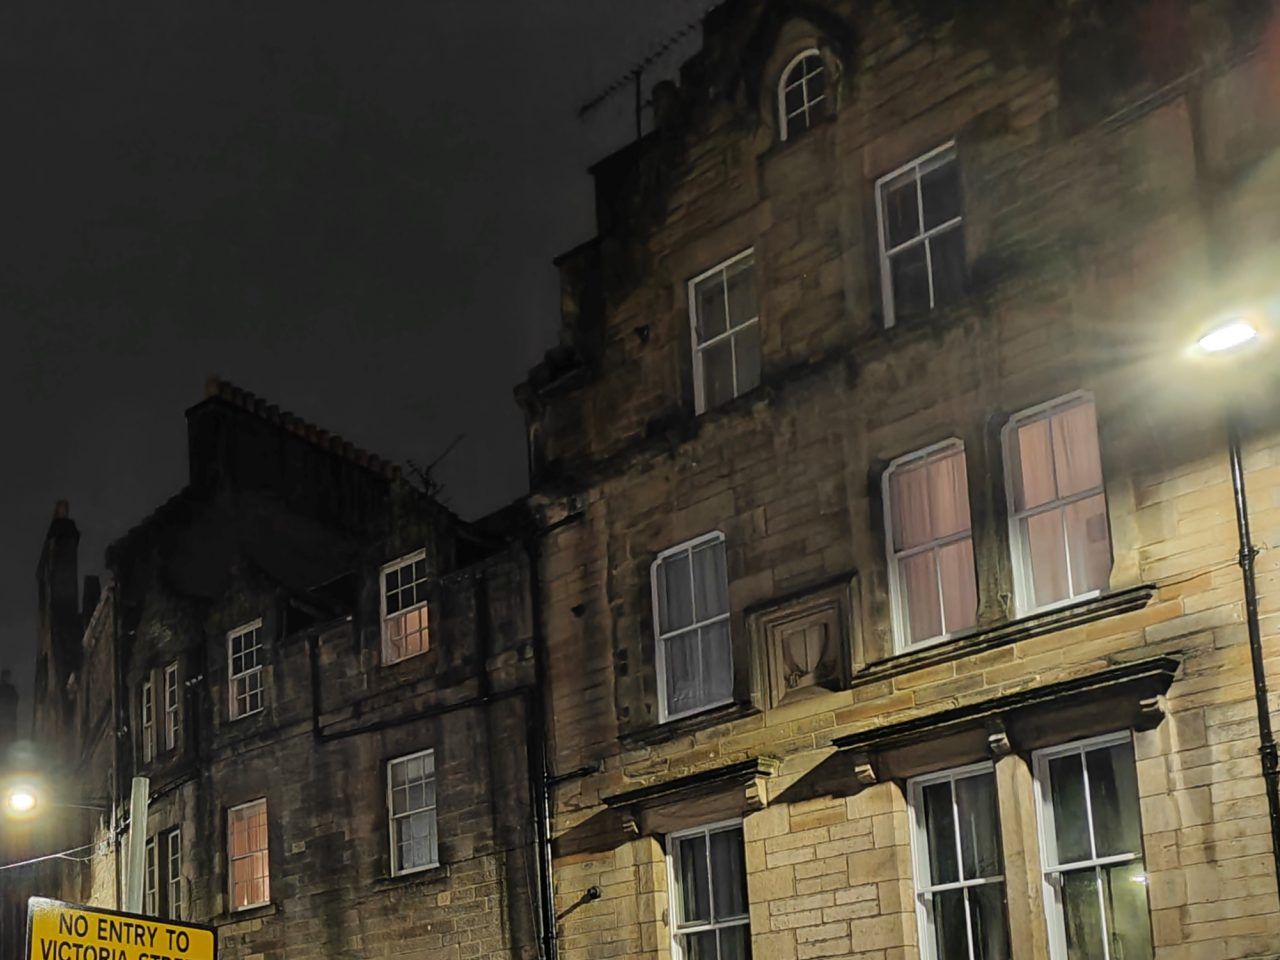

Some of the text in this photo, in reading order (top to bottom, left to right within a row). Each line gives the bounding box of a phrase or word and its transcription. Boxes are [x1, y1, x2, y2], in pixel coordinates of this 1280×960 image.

[59, 913, 190, 953] NO ENTRY TO
